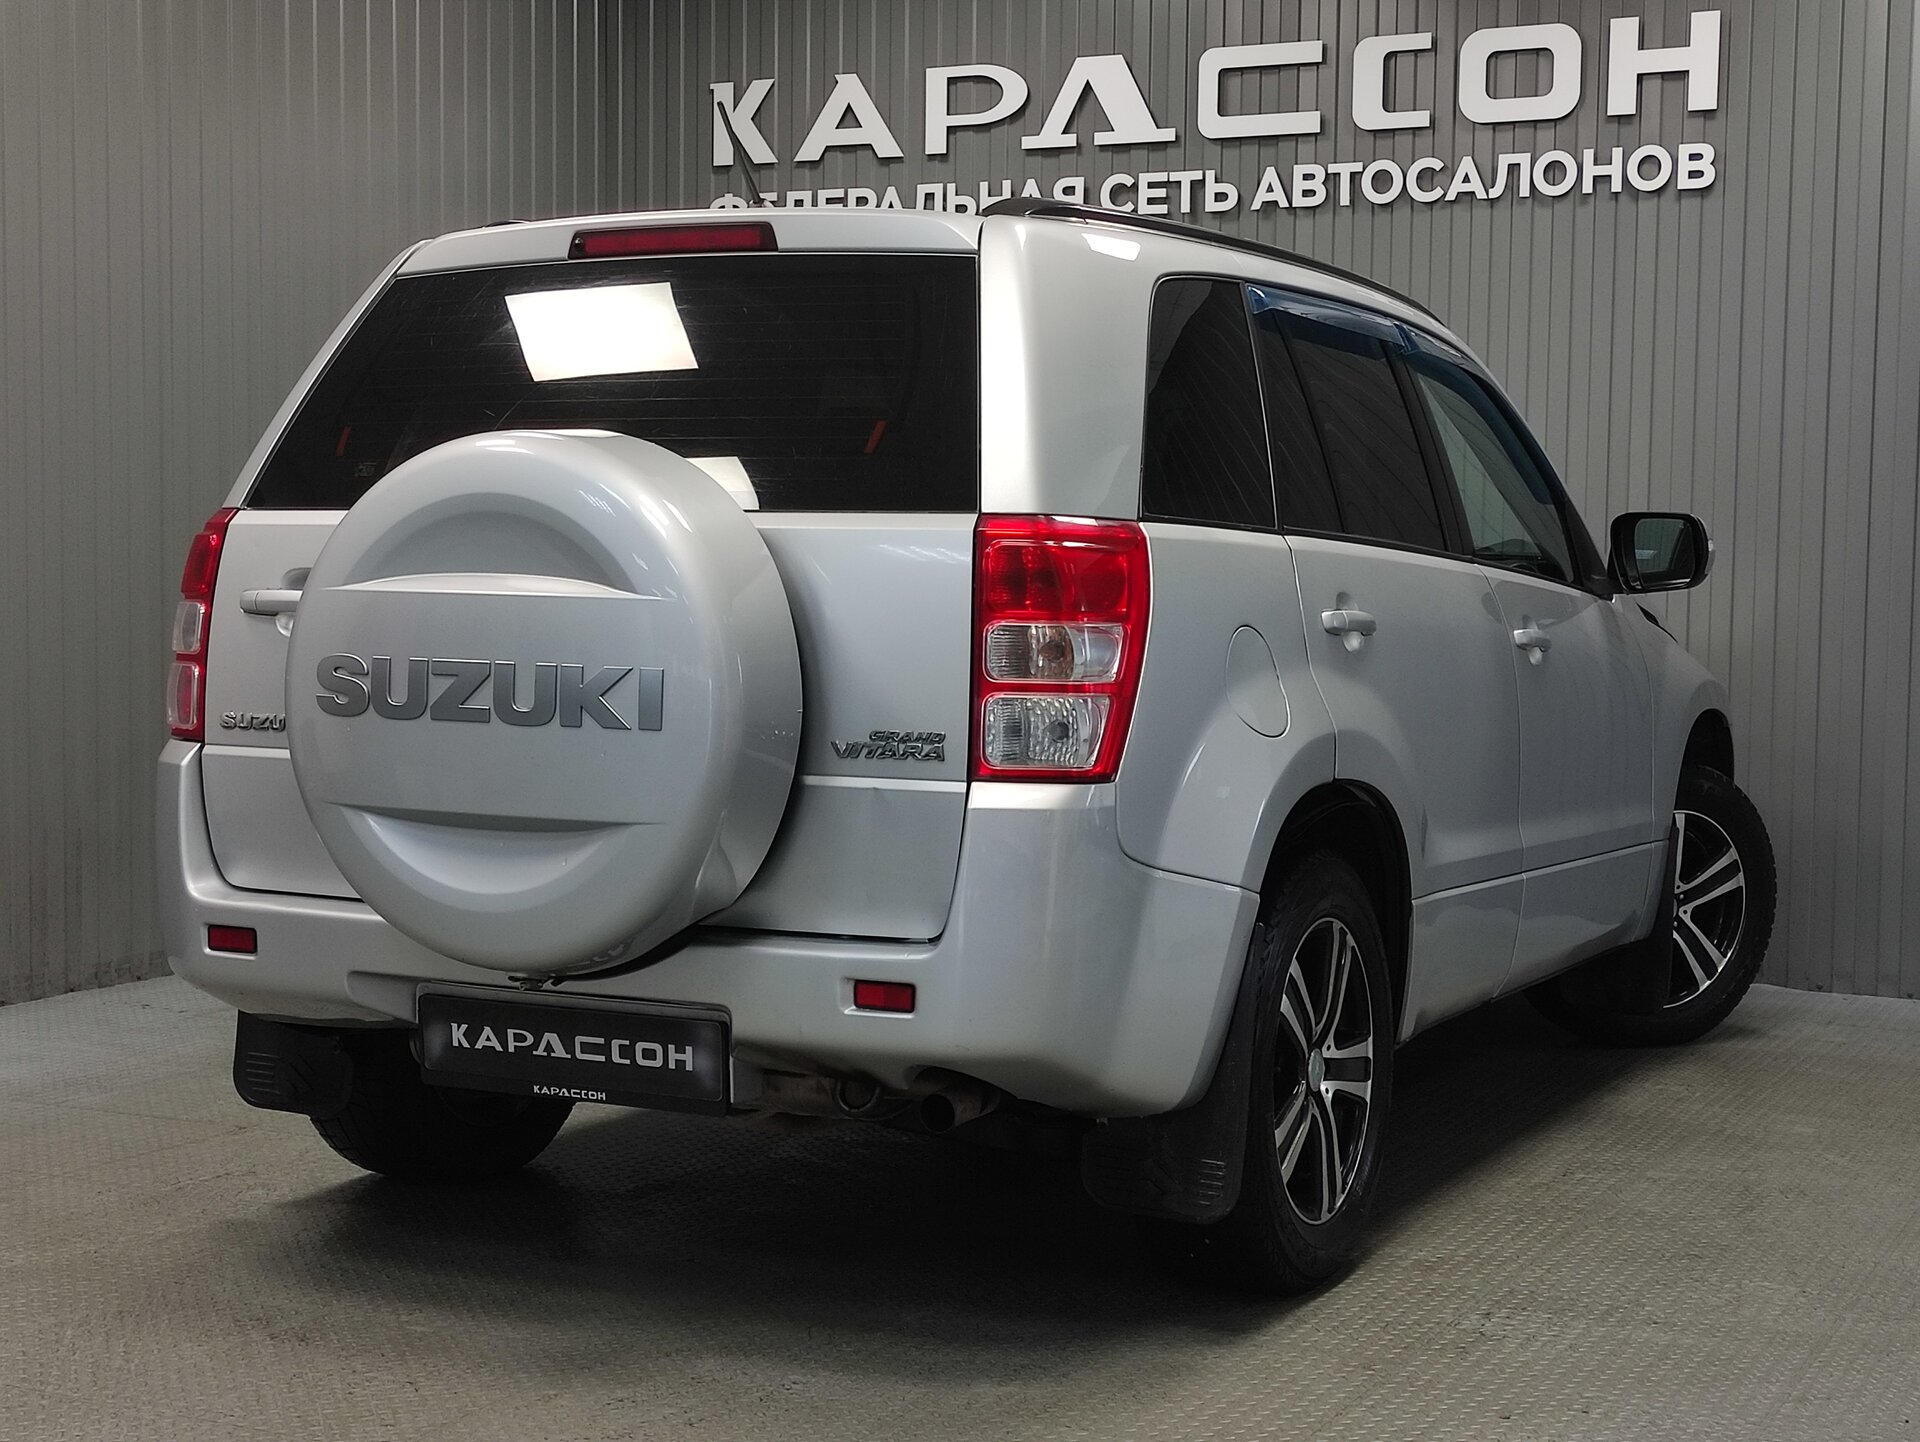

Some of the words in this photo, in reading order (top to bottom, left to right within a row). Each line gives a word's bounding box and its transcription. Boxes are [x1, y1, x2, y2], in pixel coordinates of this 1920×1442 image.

[710, 176, 1085, 212] РАЛЬНЯ
[1101, 170, 1239, 214] СЕТЬ
[1250, 142, 1716, 211] АВТОСАЛОНОВ
[316, 652, 664, 731] SUZUKI
[830, 740, 945, 761] VITARA
[868, 730, 946, 744] GRAND
